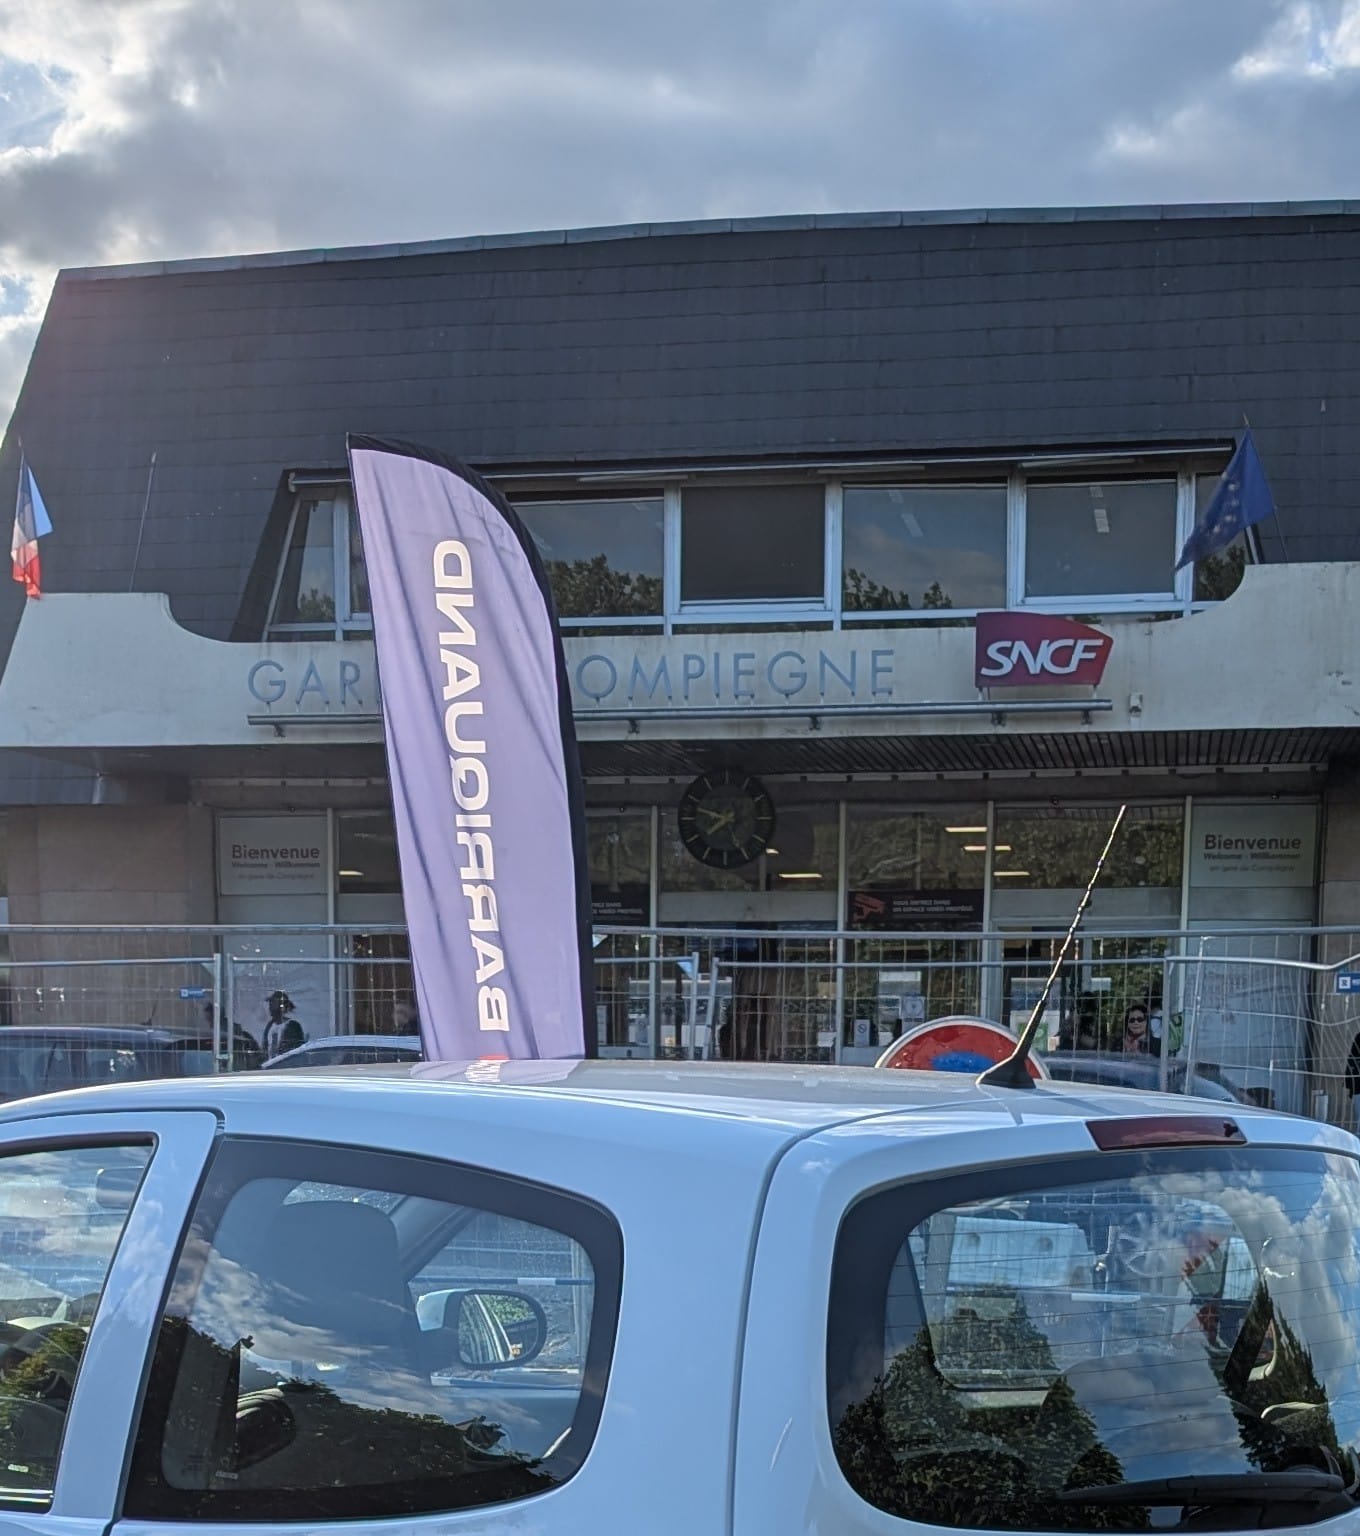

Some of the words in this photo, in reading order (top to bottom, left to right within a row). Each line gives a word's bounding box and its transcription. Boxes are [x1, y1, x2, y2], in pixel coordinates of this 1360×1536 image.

[980, 639, 1103, 676] SNCF
[247, 659, 364, 704] GAR
[575, 648, 896, 700] OMPIEGNE
[231, 844, 321, 860] Bienvenue
[1204, 834, 1302, 850] Bienvenue
